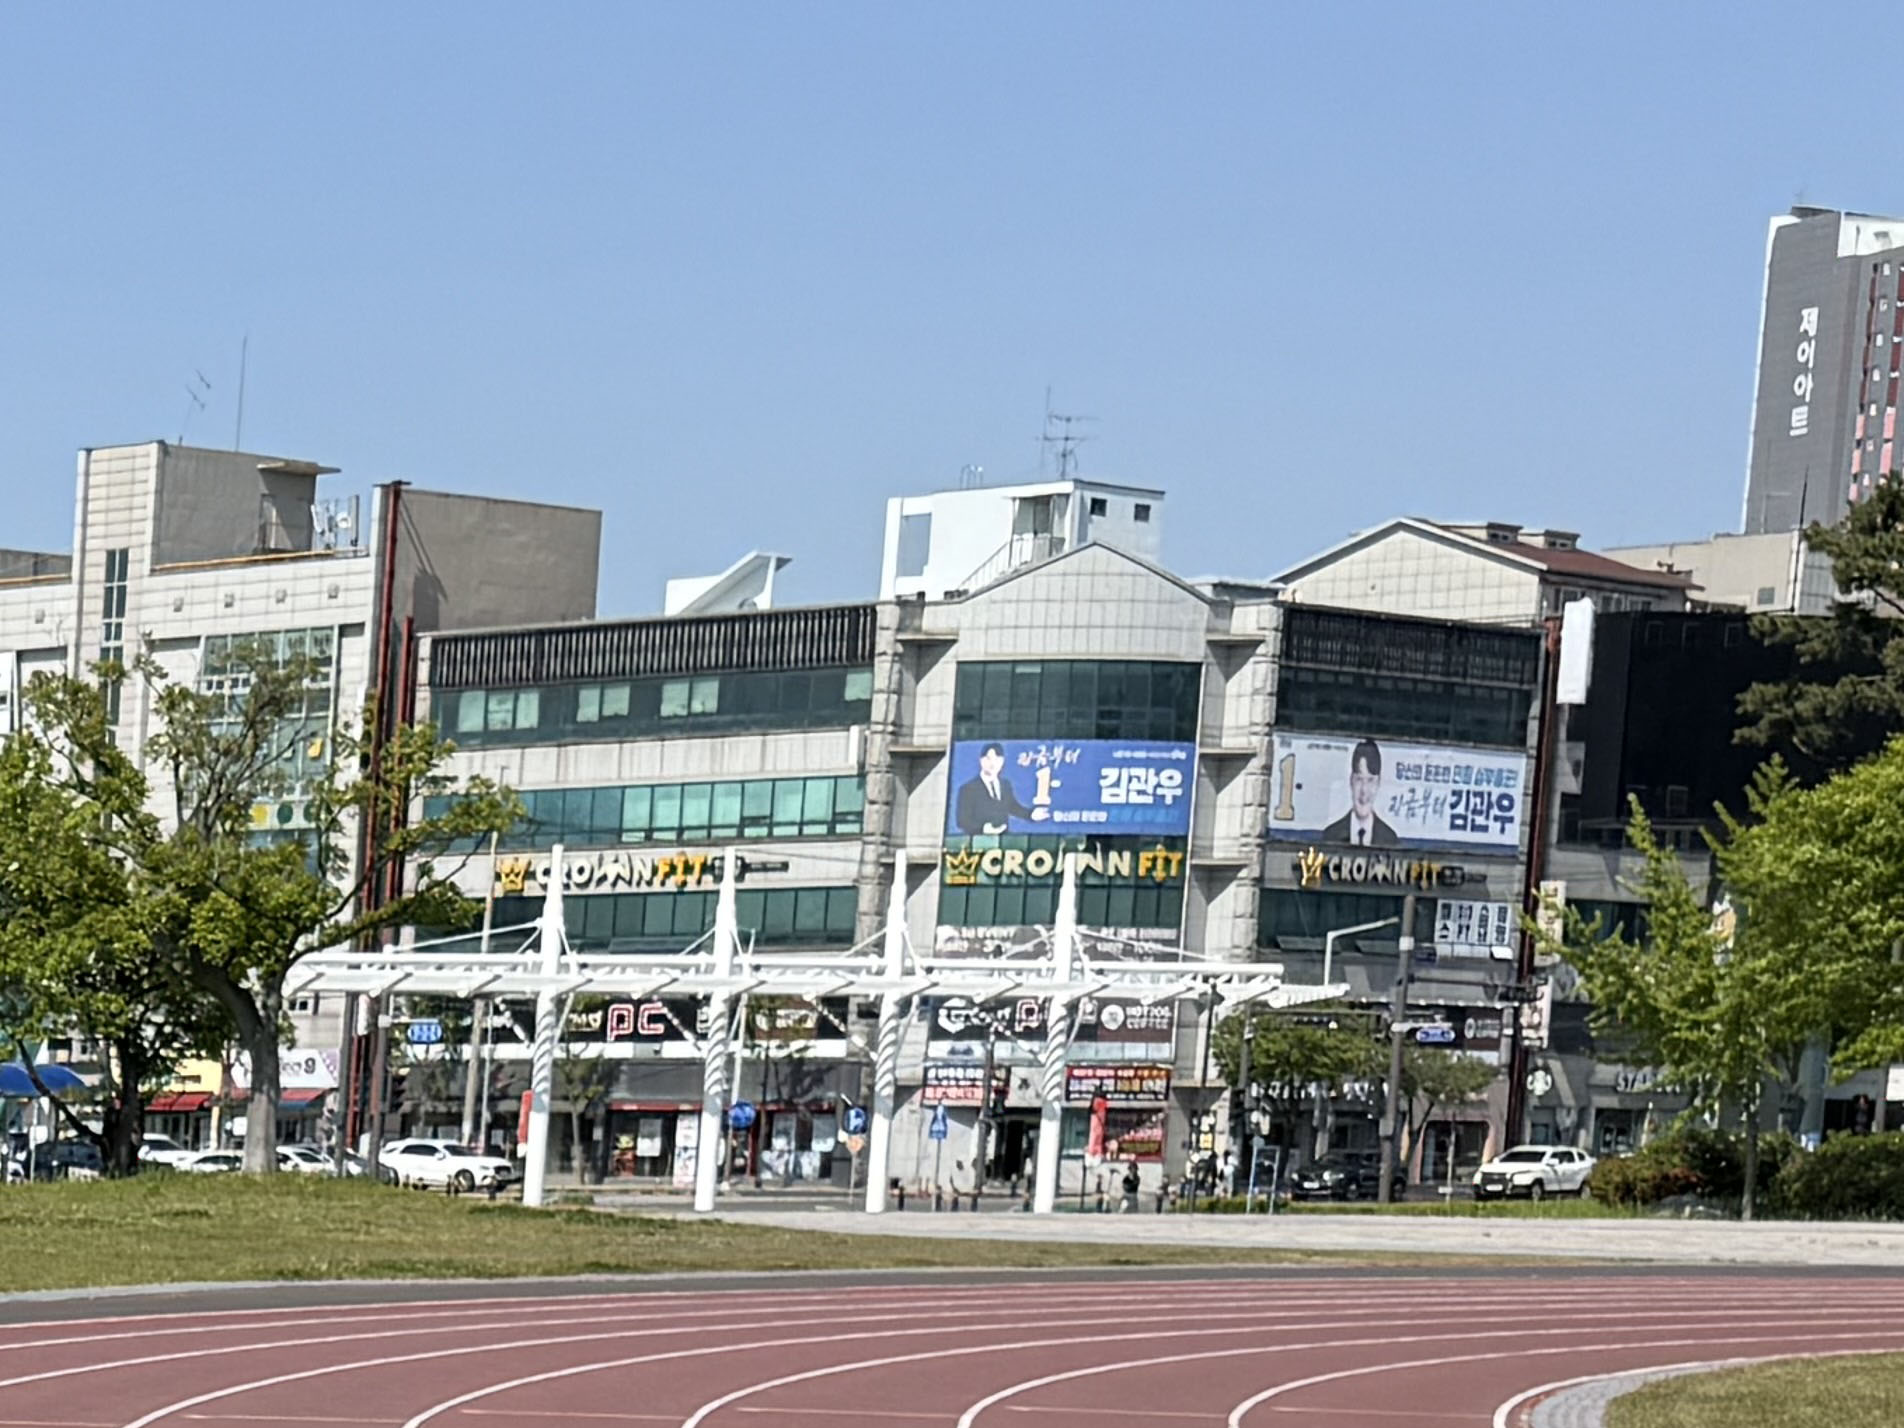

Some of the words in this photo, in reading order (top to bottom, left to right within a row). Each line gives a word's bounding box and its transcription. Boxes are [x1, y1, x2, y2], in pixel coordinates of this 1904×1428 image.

[1099, 767, 1183, 805] 김관우
[1449, 788, 1516, 835] 김관우
[1138, 844, 1183, 883] FIT
